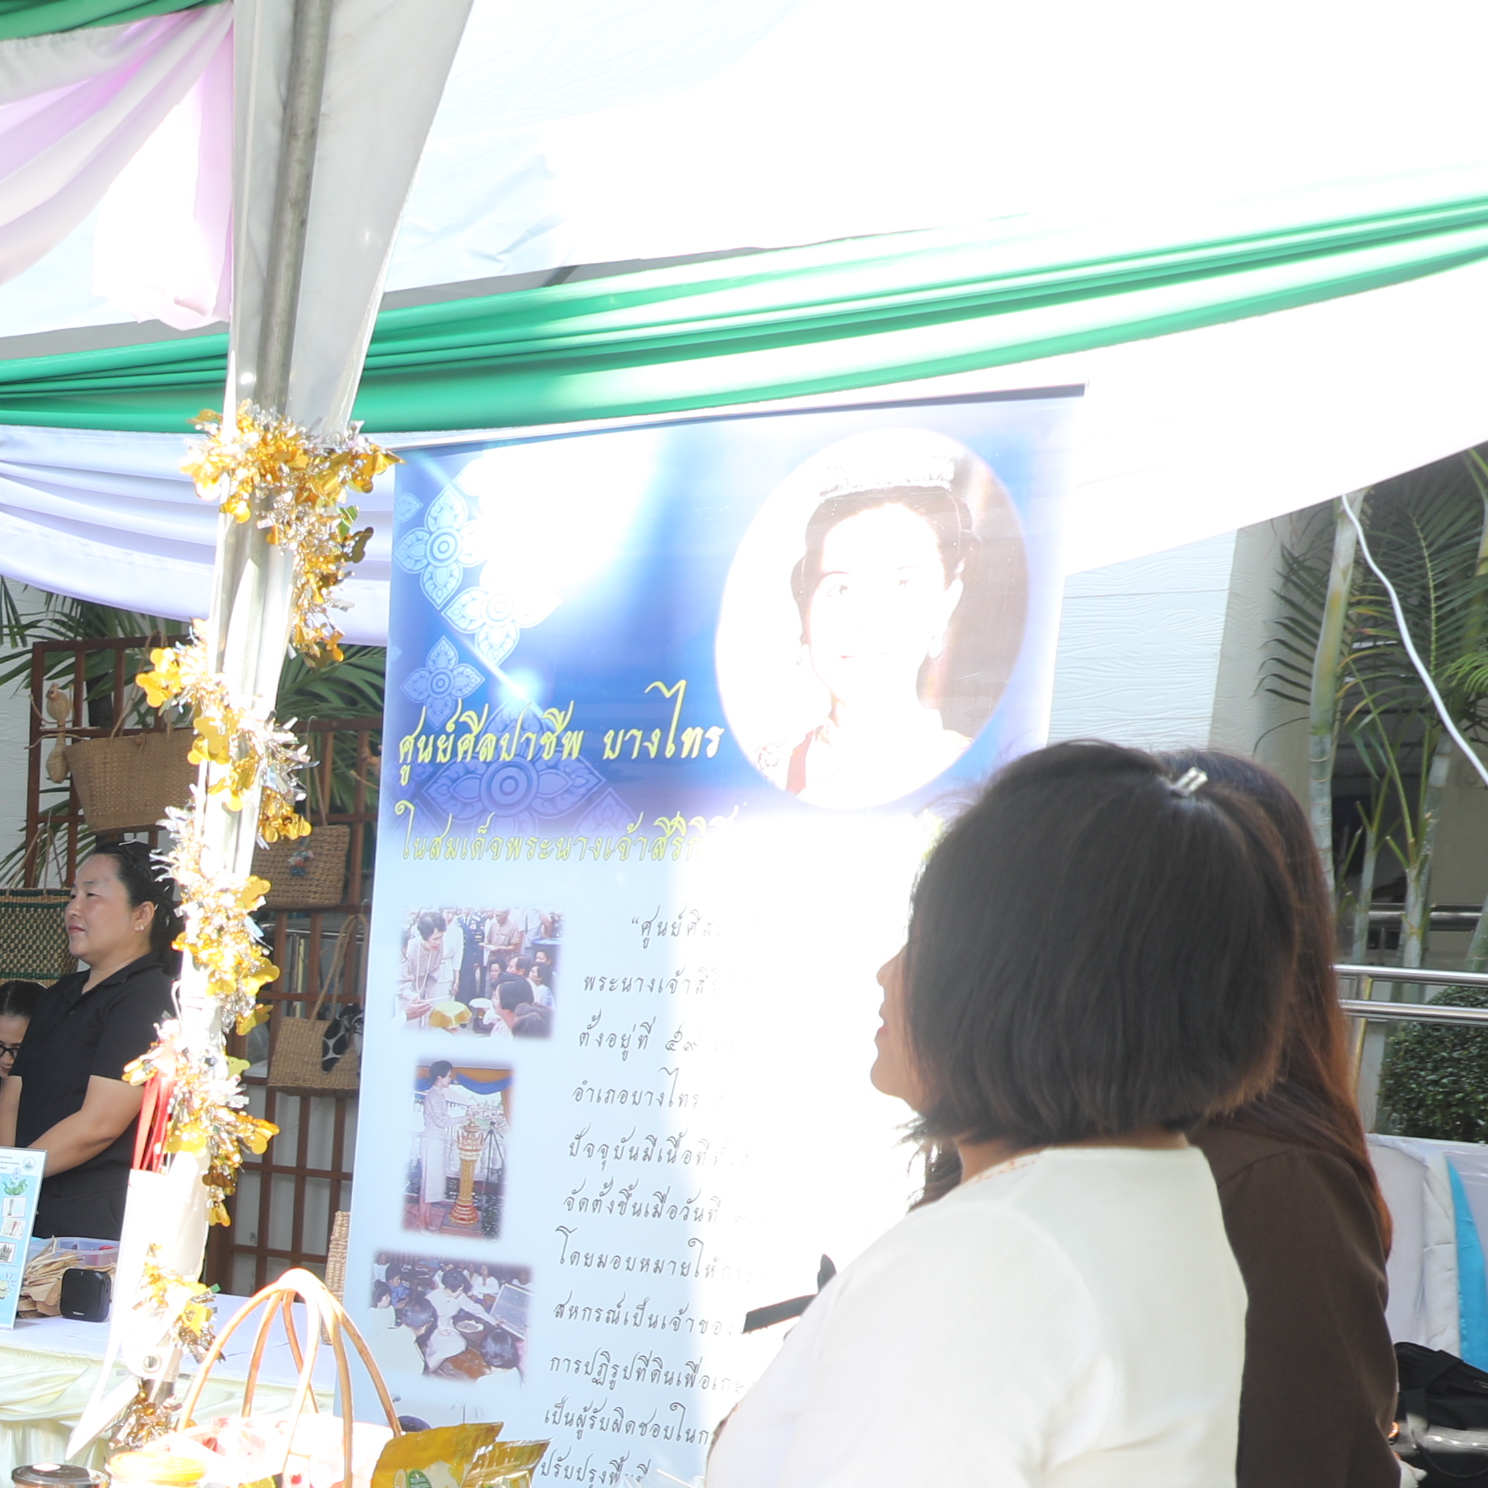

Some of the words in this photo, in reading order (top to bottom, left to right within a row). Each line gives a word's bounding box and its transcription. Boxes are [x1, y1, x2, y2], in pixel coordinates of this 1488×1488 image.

[398, 699, 585, 786] ศูนย์ศิลปาชีพ
[603, 680, 725, 760] บางไทร
